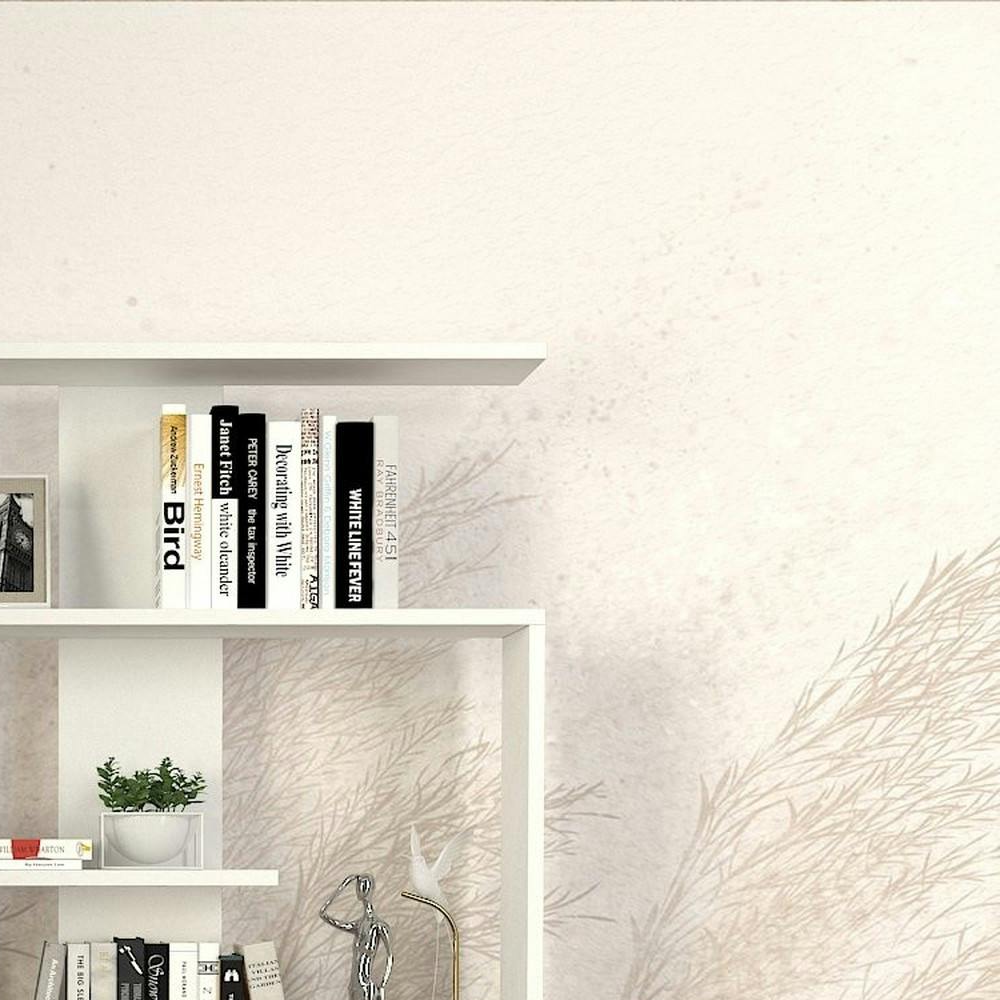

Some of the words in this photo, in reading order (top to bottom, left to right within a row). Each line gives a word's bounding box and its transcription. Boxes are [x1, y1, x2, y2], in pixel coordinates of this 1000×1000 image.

[219, 419, 231, 457] Janet
[248, 439, 257, 466] PETER
[194, 463, 204, 495] Ernest
[219, 461, 232, 495] Fitch
[248, 470, 257, 499] CAREY
[271, 445, 292, 508] Decorating
[349, 489, 362, 529] WHITE
[385, 464, 396, 528] FAHRENHEIT
[190, 498, 204, 560] Hemingway
[219, 503, 231, 537] white
[248, 509, 256, 523] the
[276, 513, 291, 538] with
[164, 502, 185, 570] Bird
[349, 531, 361, 560] LINE
[385, 531, 396, 560] 451
[219, 542, 232, 596] oleander
[246, 543, 257, 584] inspector
[276, 542, 291, 577] White
[348, 562, 361, 602] FEVER
[148, 954, 165, 1000] Snow
